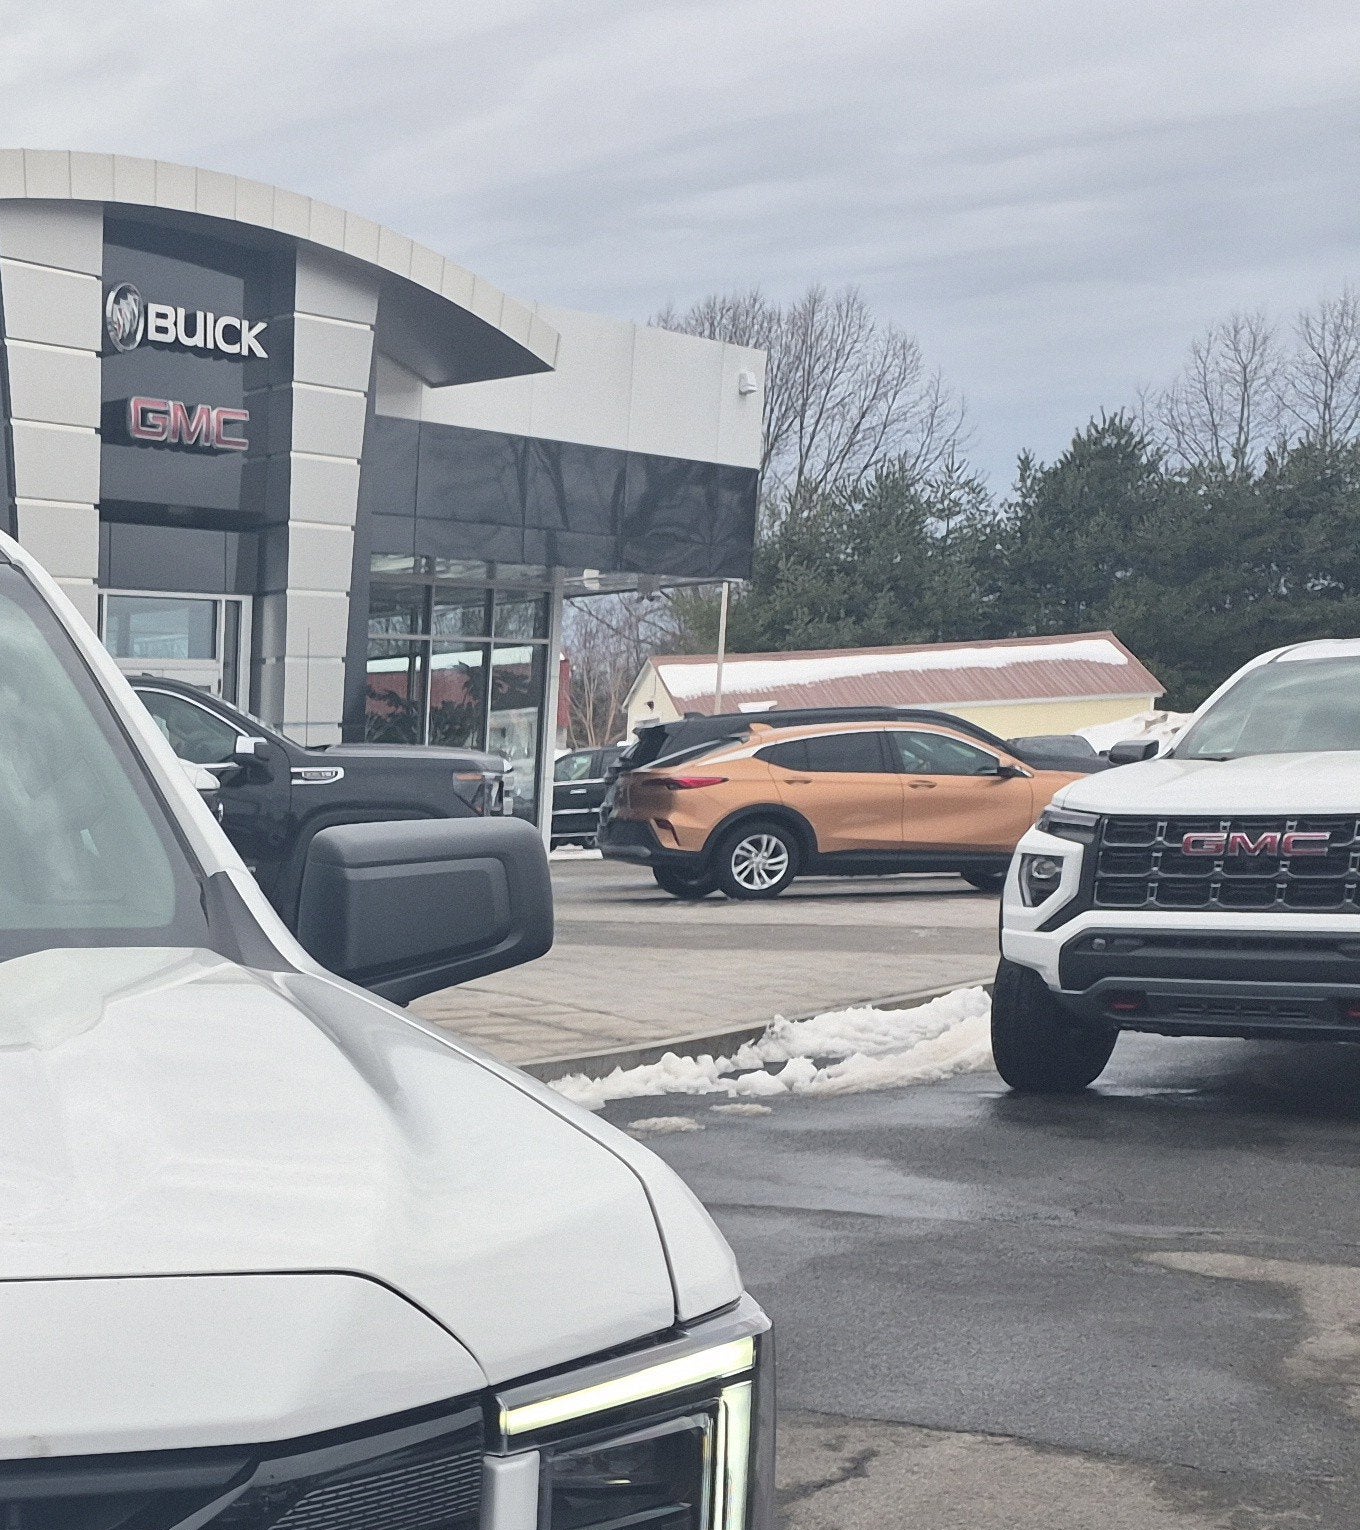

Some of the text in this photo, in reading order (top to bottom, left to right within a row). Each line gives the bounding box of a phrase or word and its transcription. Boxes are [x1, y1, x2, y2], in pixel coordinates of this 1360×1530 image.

[147, 302, 269, 359] BUICK
[130, 396, 250, 450] GMC
[1182, 832, 1331, 857] GMC
